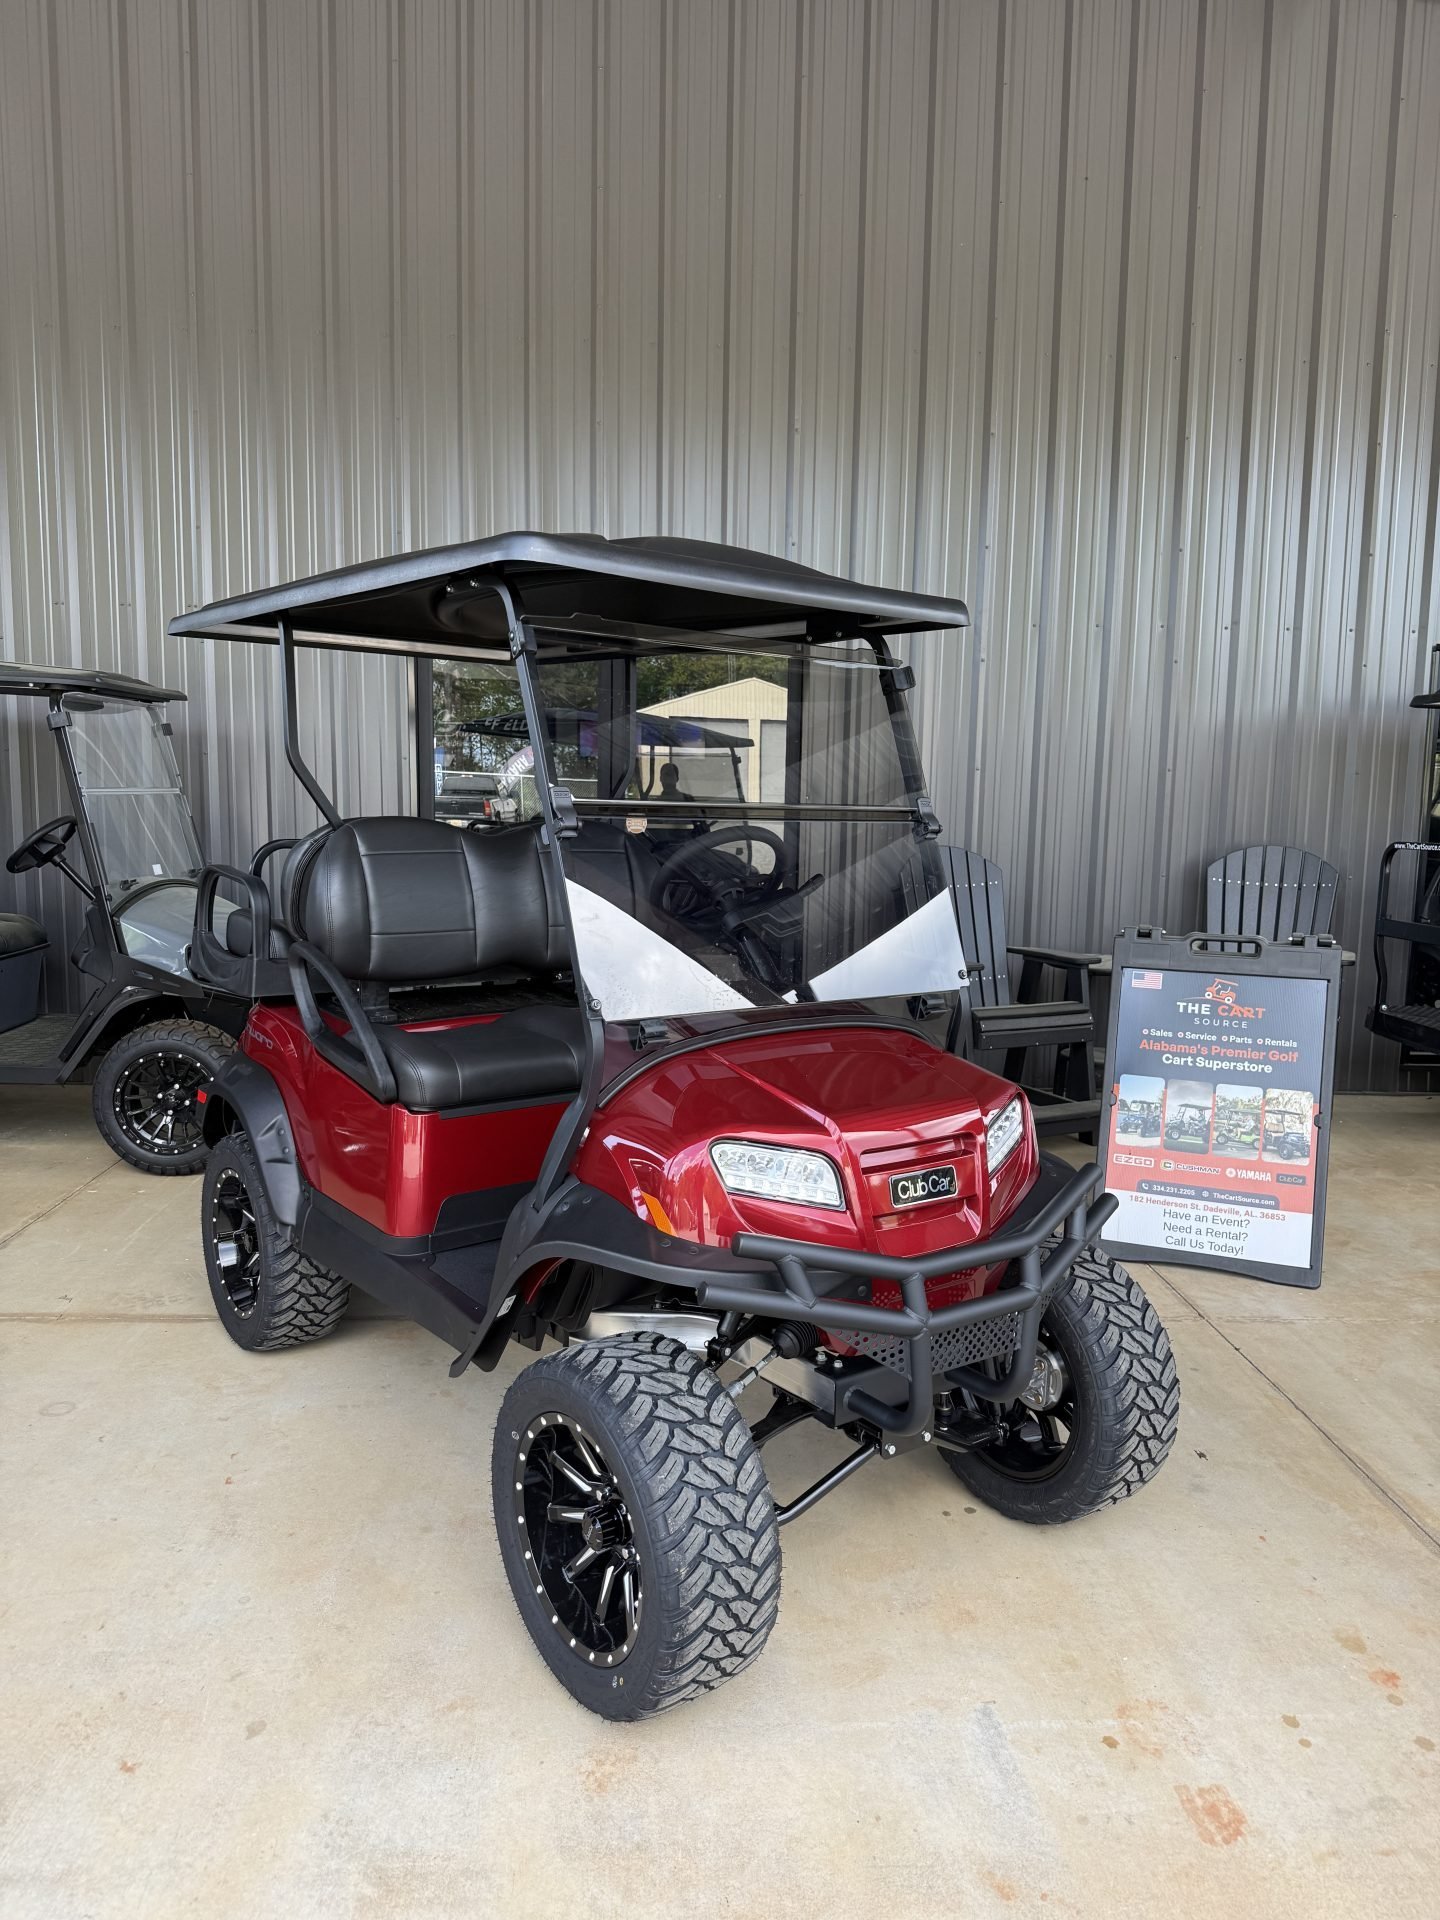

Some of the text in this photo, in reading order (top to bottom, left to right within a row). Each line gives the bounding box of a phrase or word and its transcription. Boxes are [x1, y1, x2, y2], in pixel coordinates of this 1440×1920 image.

[1177, 1002, 1266, 1019] THE CART
[1194, 1017, 1248, 1028] SOURCE
[1150, 1028, 1298, 1048] Sales Service Parts Rentals
[1139, 1039, 1298, 1063] Alabama's Premier Golf
[1162, 1053, 1273, 1073] Cart Superstore
[1114, 1155, 1154, 1167] EZGO
[1176, 1163, 1220, 1174] CUSHMAN
[1236, 1169, 1272, 1182] YAMAHA
[1152, 1184, 1196, 1196] 334.231.2205
[1212, 1192, 1275, 1206] TheCartSource.com
[1129, 1194, 1144, 1203] 182
[1146, 1196, 1188, 1209] Henderson
[1203, 1204, 1242, 1217] Dadeville,
[1244, 1209, 1258, 1219] AL.
[1260, 1211, 1286, 1222] 36853
[1163, 1208, 1250, 1228] Have an Event?
[1163, 1221, 1248, 1242] Need a Rental?
[1165, 1235, 1244, 1256] Call Us Today!
